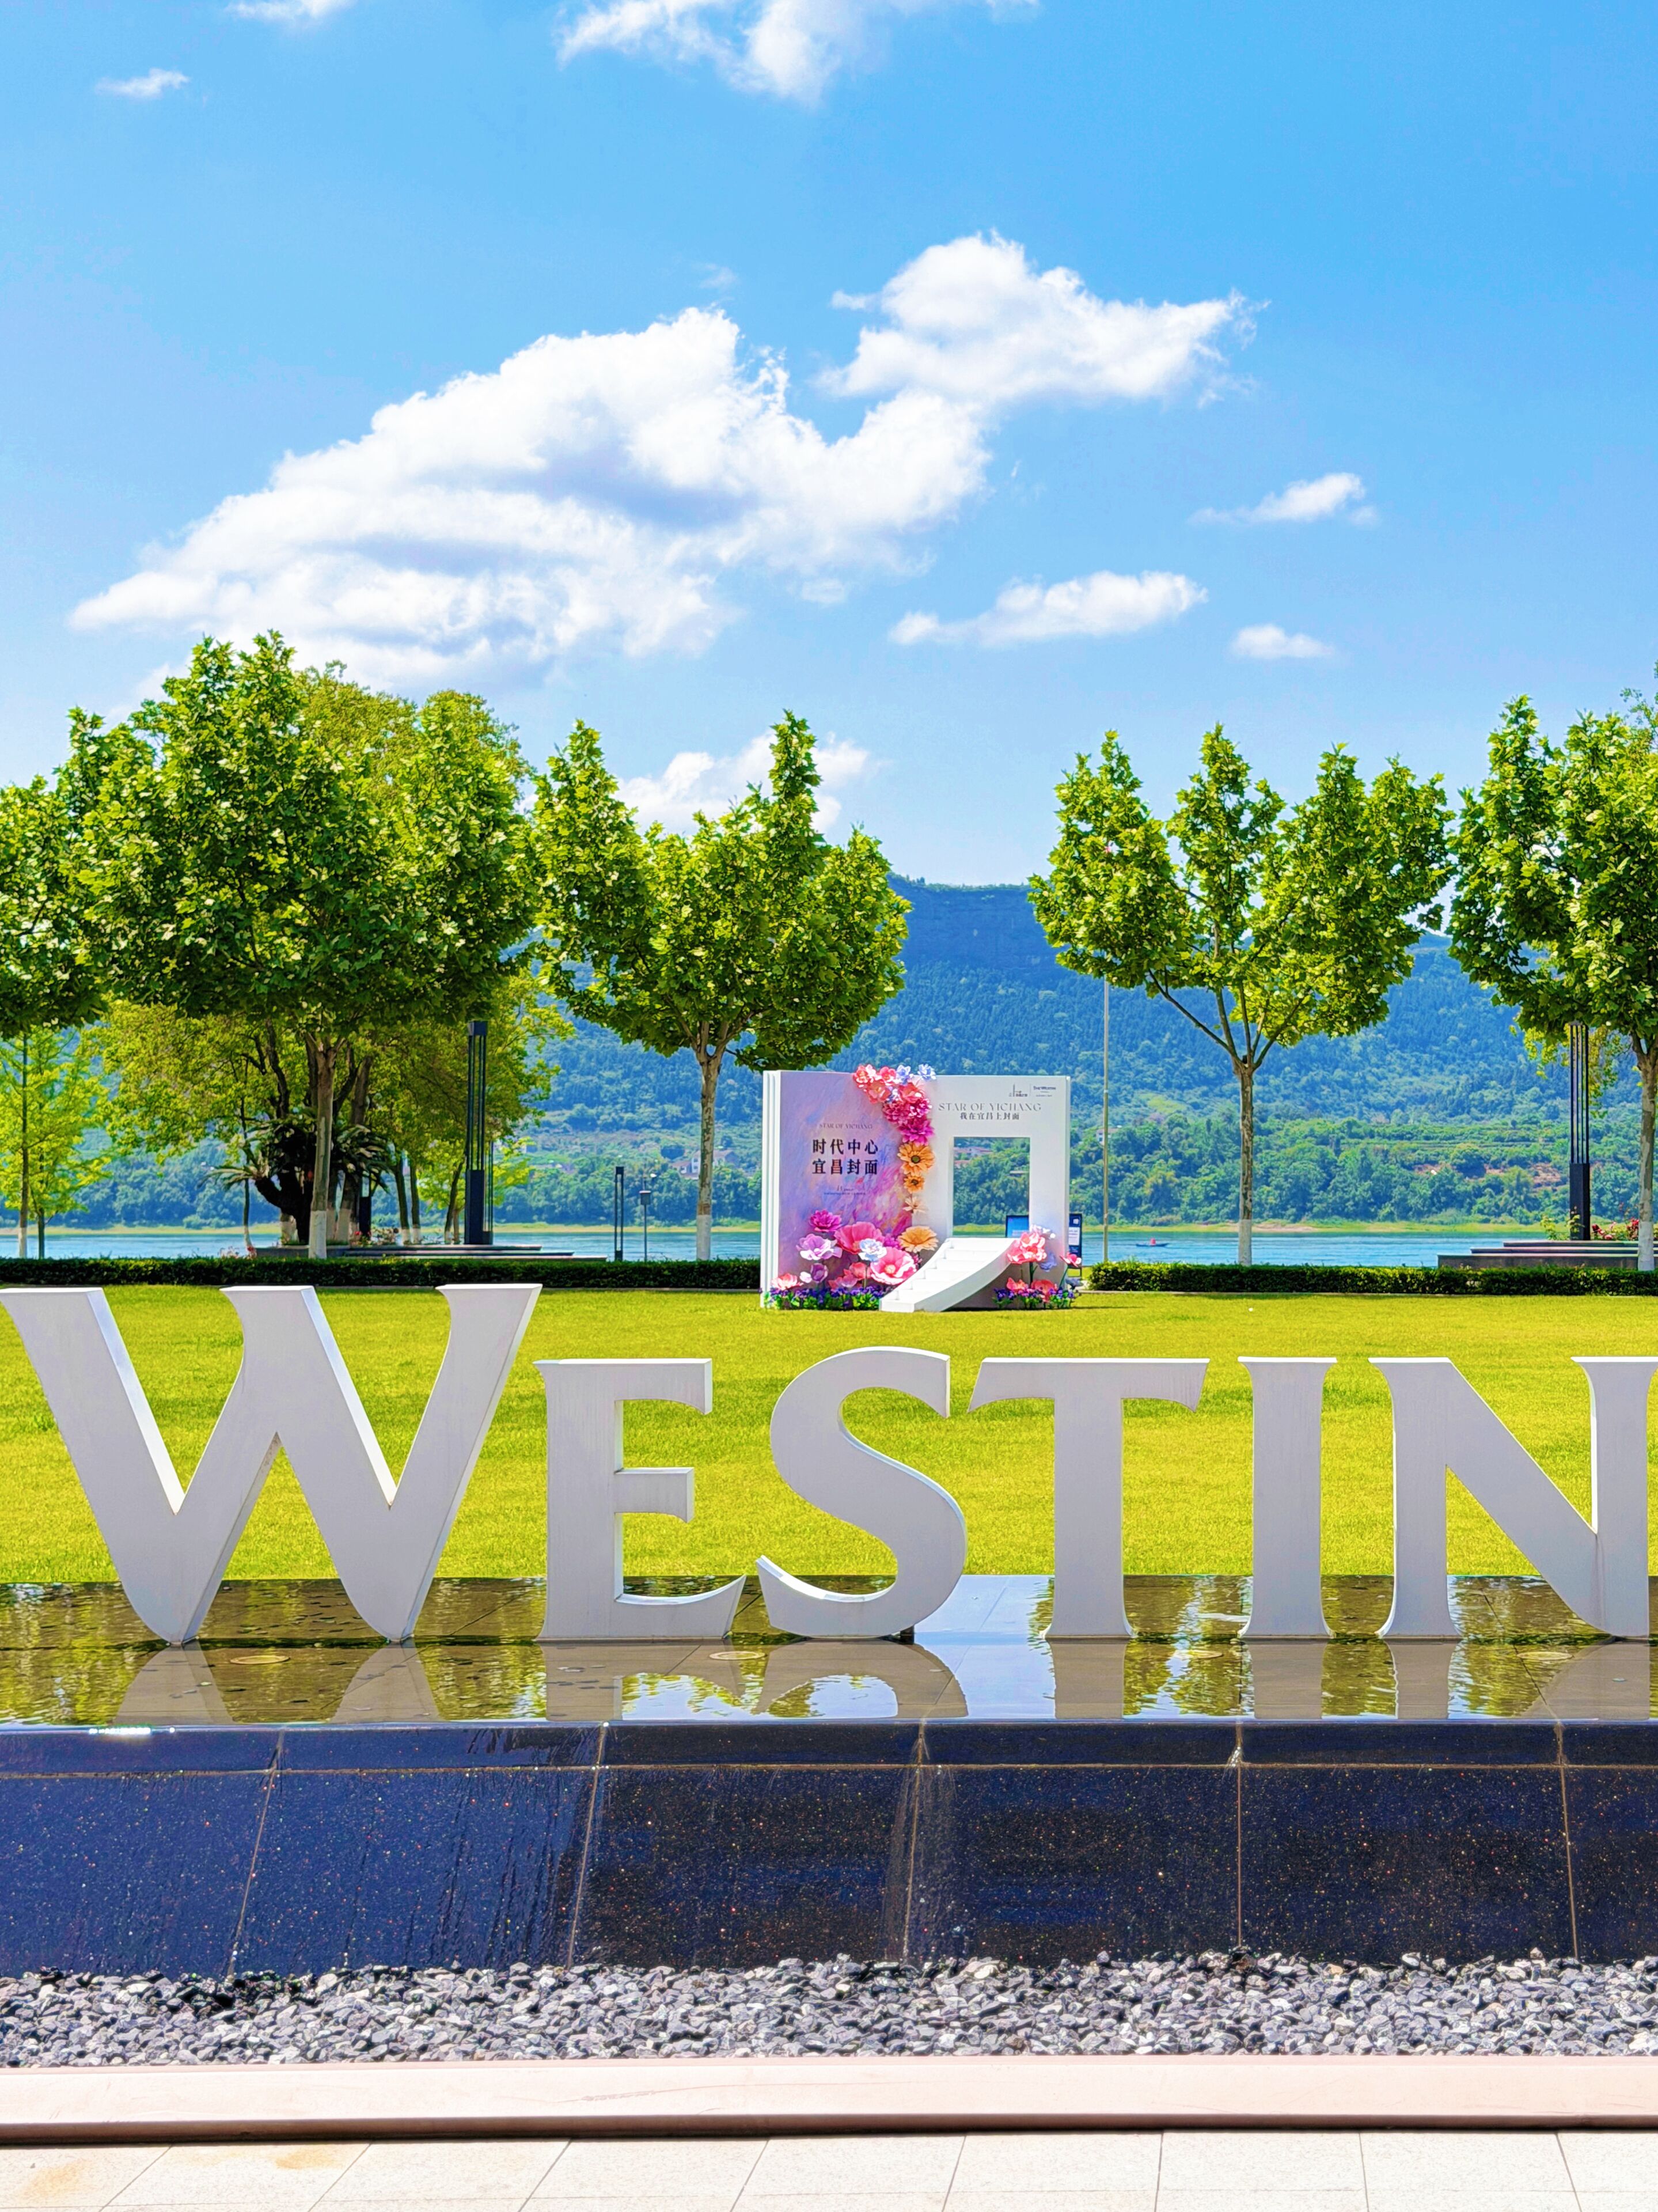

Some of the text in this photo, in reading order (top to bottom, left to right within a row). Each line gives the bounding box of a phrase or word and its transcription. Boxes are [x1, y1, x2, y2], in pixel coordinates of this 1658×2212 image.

[938, 1103, 1041, 1112] STAR OF YICHANG
[960, 1112, 1019, 1120] 我在宜昌上封面
[813, 1138, 878, 1154] 时代中心
[812, 1158, 878, 1175] 宜昌封面
[0, 1283, 1658, 1645] WESTIN
